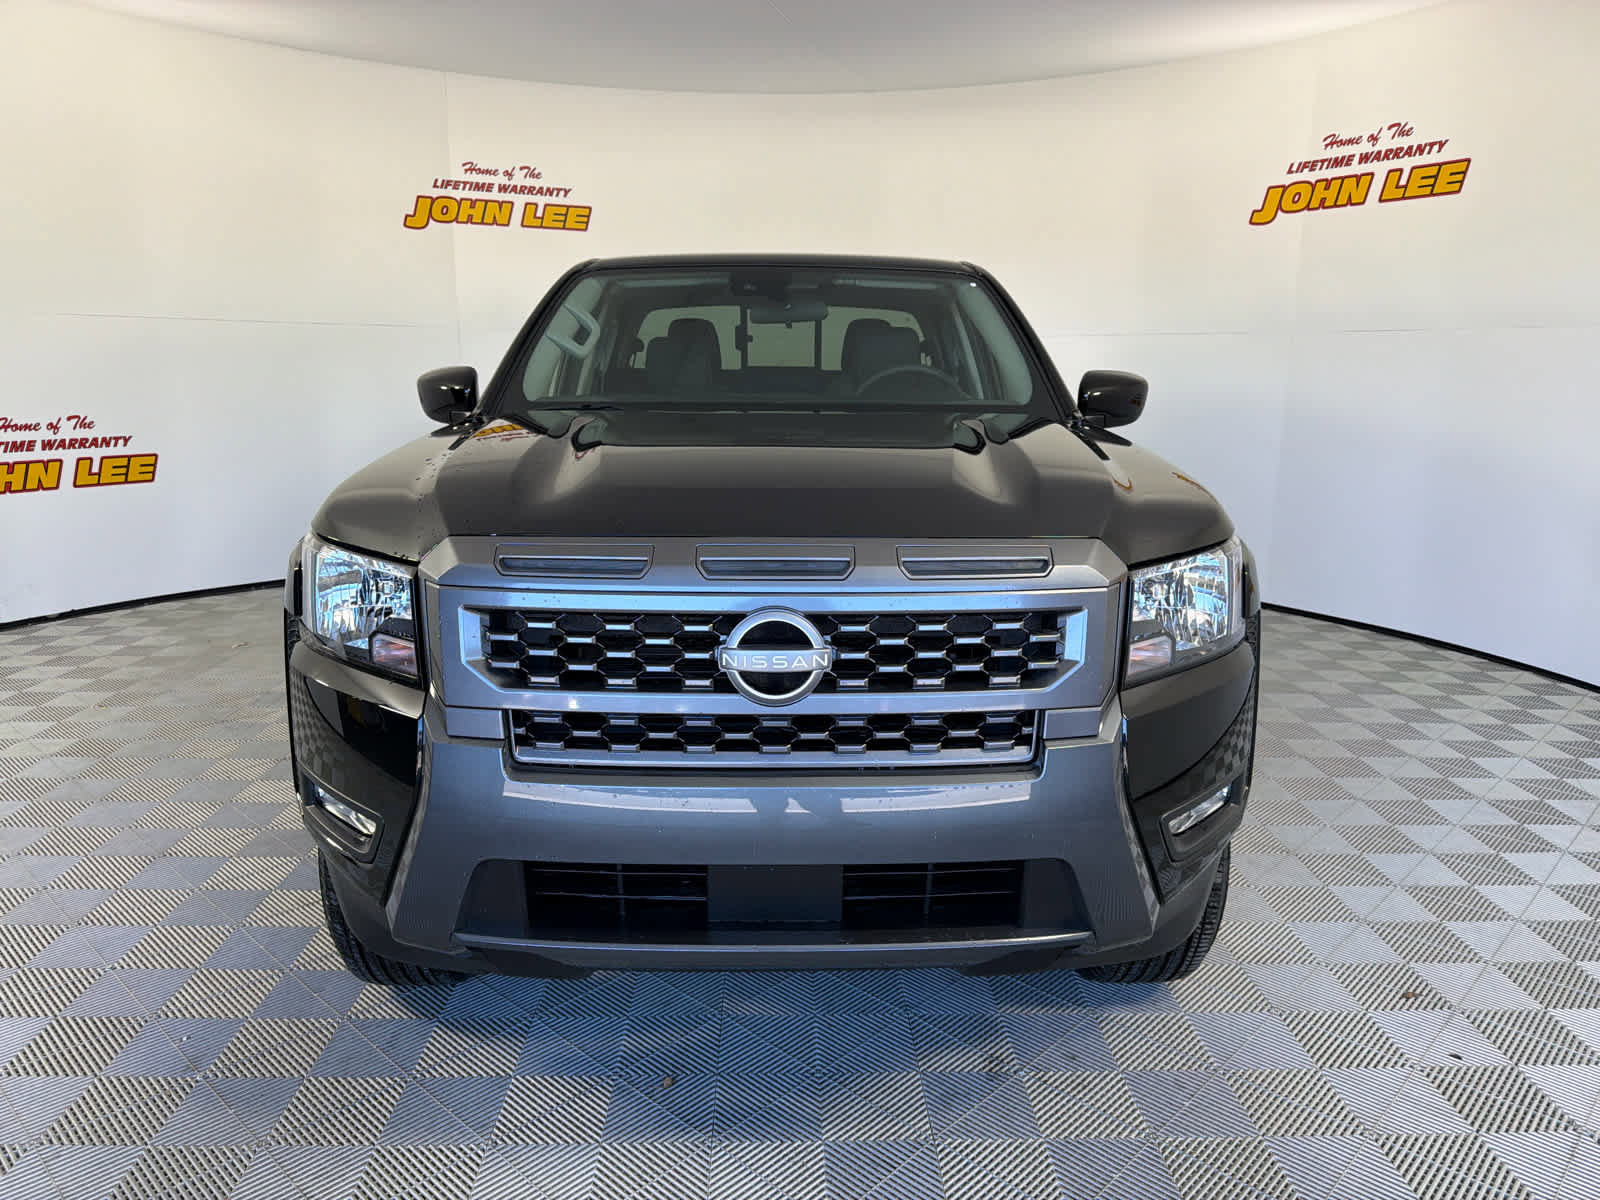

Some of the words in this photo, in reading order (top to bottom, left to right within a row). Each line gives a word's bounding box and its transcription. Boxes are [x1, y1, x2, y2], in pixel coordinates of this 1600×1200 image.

[1322, 133, 1363, 150] Home
[1366, 127, 1383, 147] of
[1386, 121, 1414, 140] The
[1286, 154, 1355, 175] LIFETIME
[1357, 139, 1450, 165] WARRANTY
[461, 161, 499, 177] Home
[502, 166, 515, 180] of
[519, 166, 543, 180] The
[432, 178, 495, 193] LIFETIME
[497, 183, 572, 198] WARRANTY
[1248, 172, 1375, 226] JOHN
[1378, 158, 1472, 203] LEE
[403, 195, 514, 230] JOHN
[520, 202, 592, 232] LEE
[46, 417, 62, 435] of
[66, 415, 96, 430] The
[41, 435, 132, 451] WARRANTY
[73, 453, 159, 488] LEE
[722, 653, 828, 669] NISSAN
